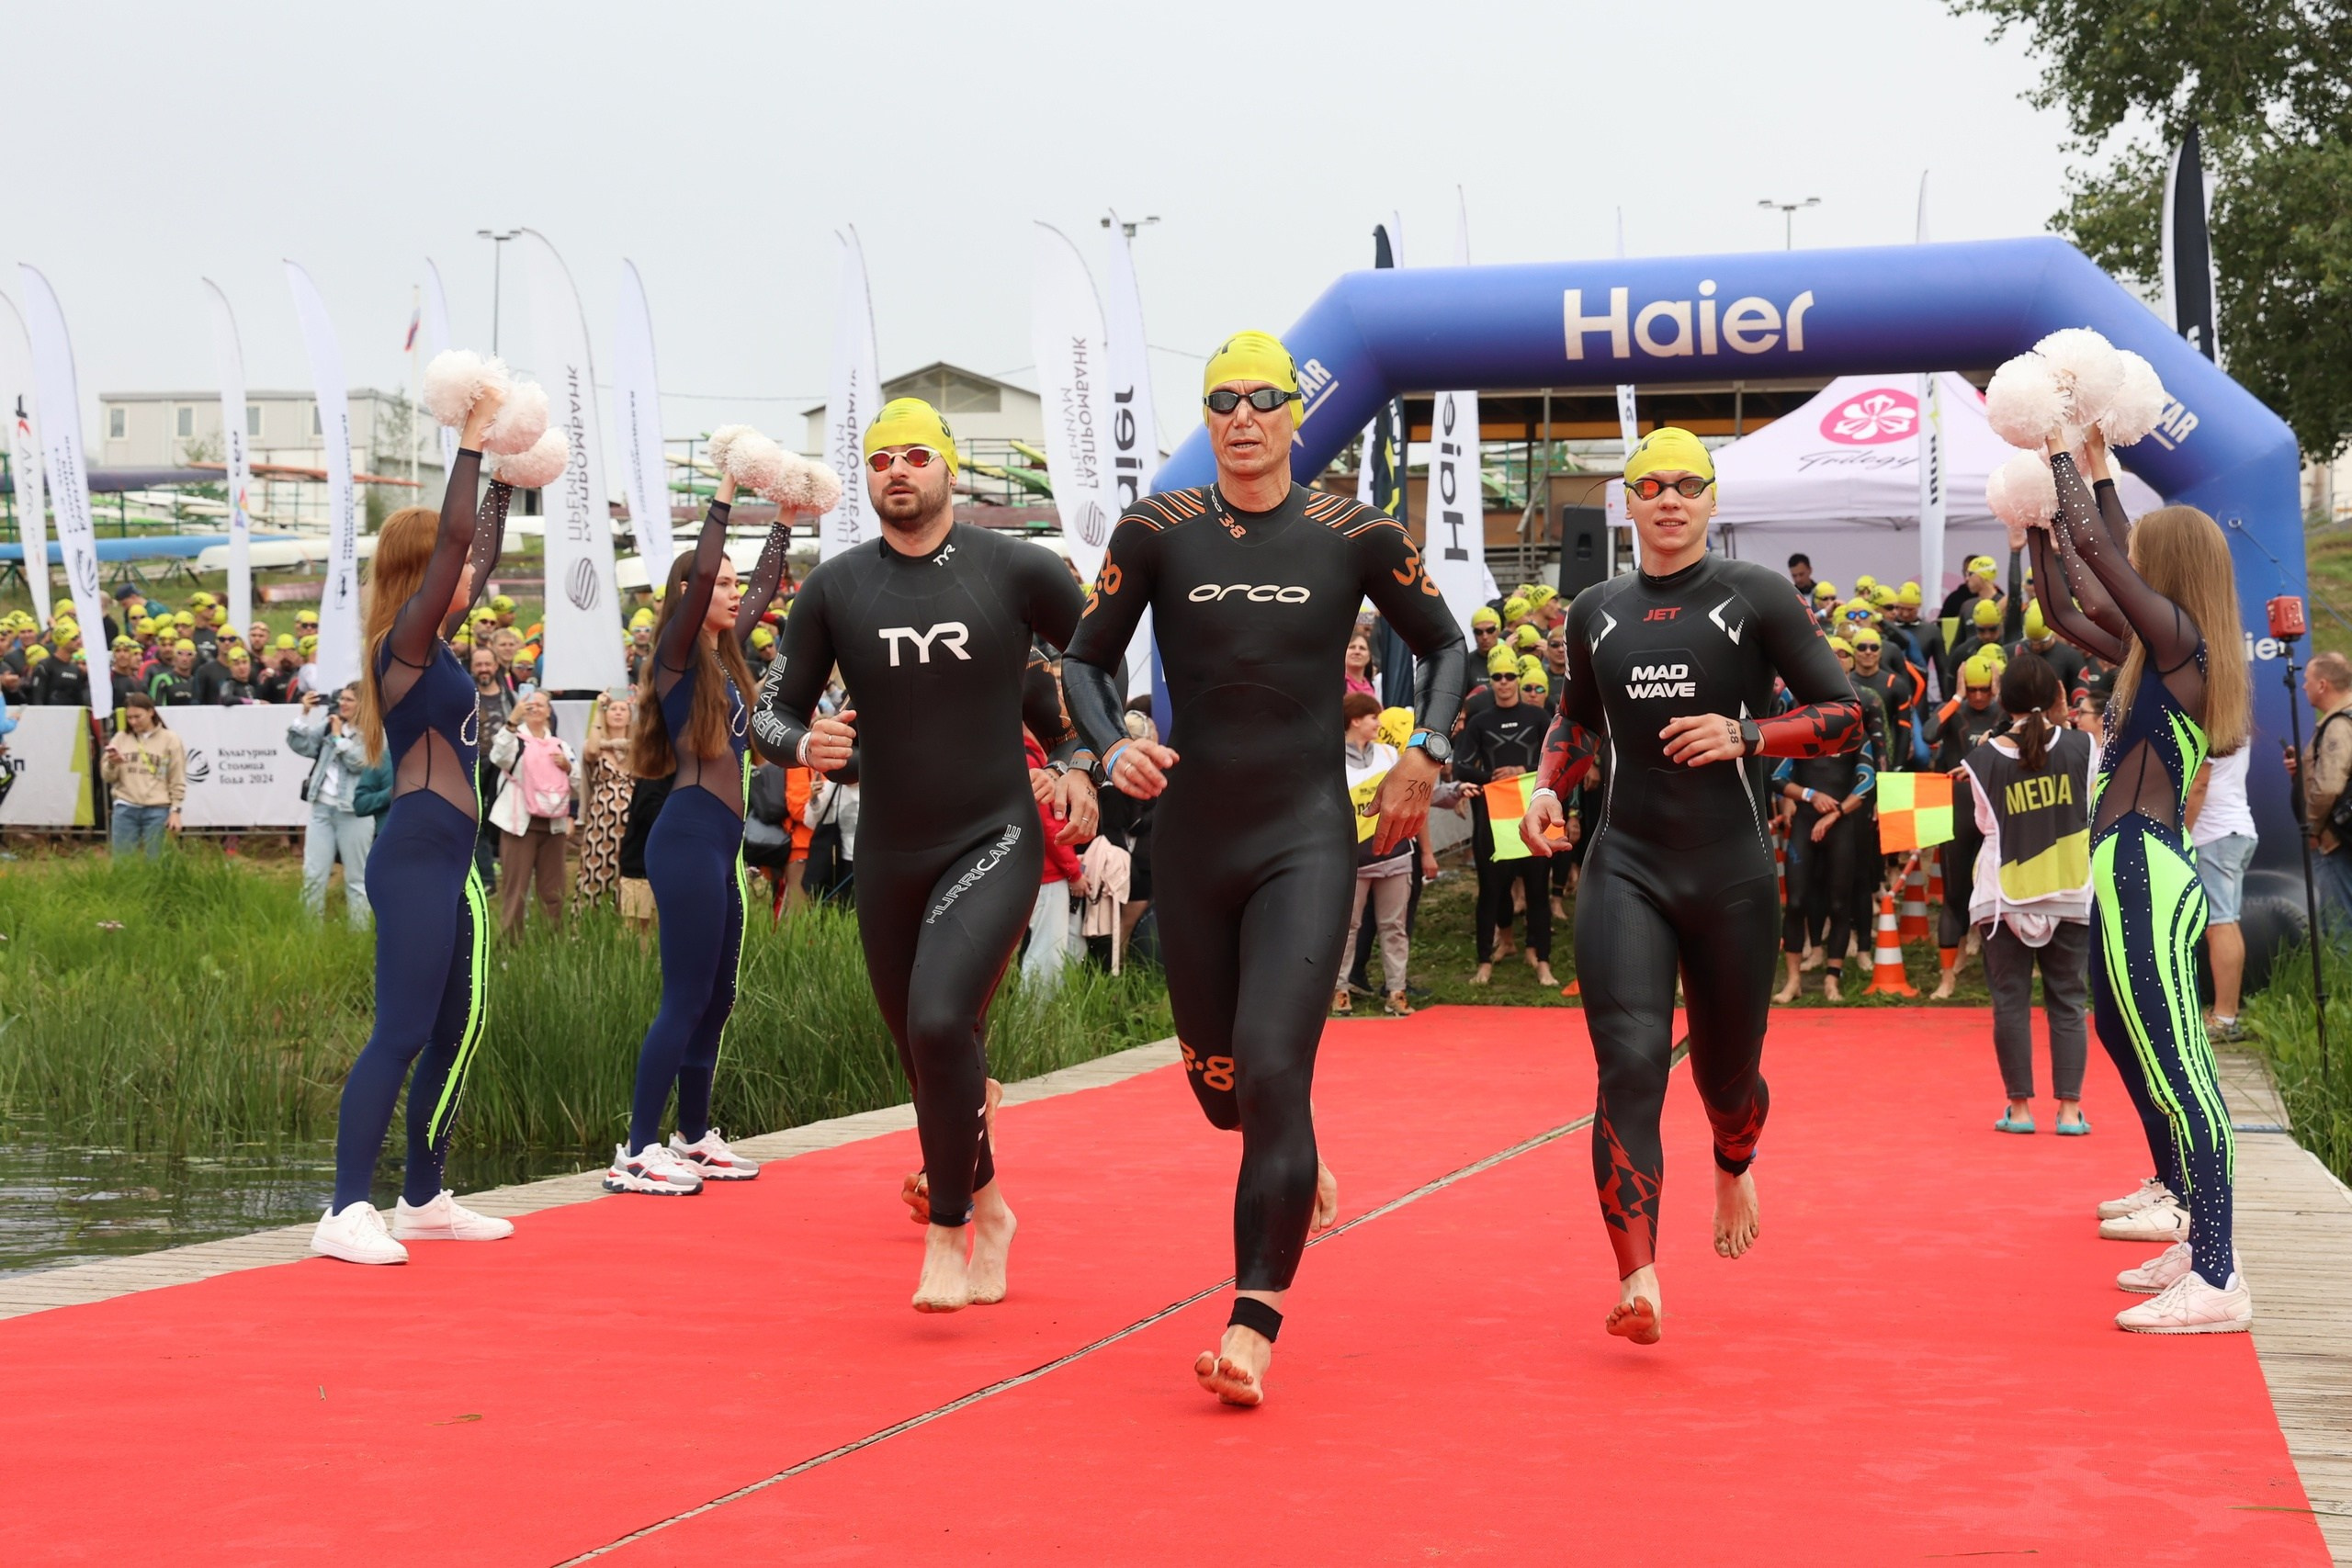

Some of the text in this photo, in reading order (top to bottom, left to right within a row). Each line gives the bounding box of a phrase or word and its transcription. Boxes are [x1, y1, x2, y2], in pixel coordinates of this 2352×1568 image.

[1564, 279, 1815, 360] Haier
[1298, 358, 1333, 404] AR
[933, 544, 956, 567] TYR
[1188, 583, 1311, 604] orca
[1643, 606, 1681, 622] JET
[878, 621, 972, 667] TYR
[2245, 631, 2286, 660] ier
[1631, 663, 1689, 682] MAD
[1625, 682, 1696, 699] WAVE
[1725, 719, 1739, 744] 438
[925, 824, 1022, 924] HURRICANE
